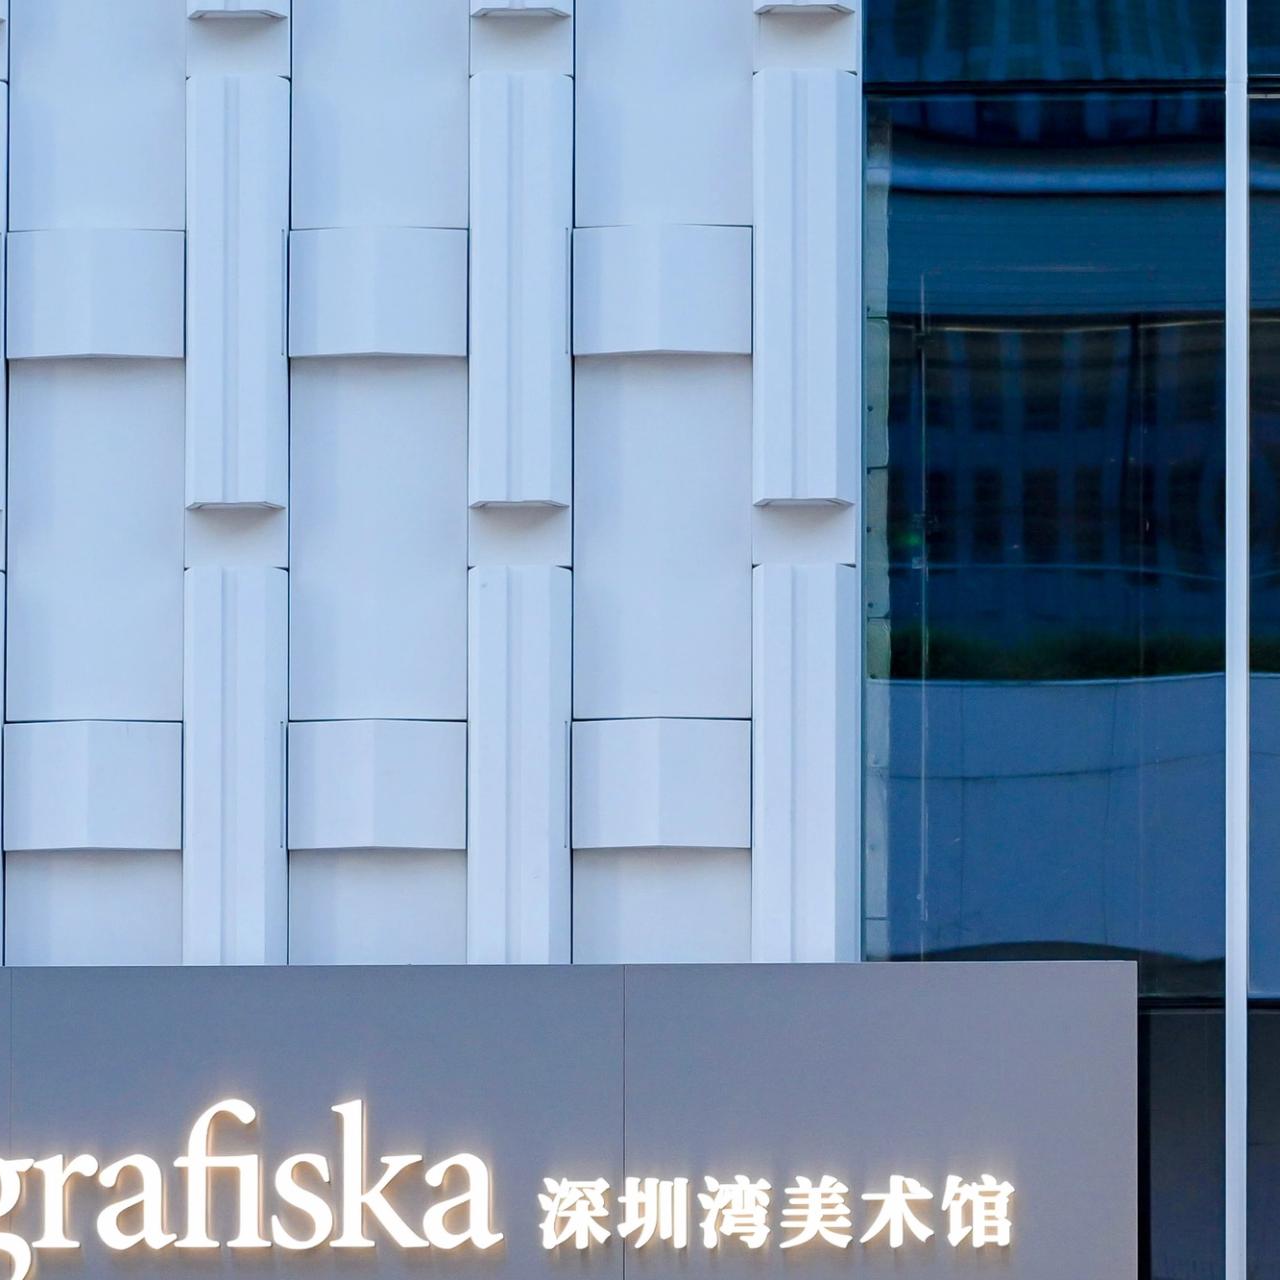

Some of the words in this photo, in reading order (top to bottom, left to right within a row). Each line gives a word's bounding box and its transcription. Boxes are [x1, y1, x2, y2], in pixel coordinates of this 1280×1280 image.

[537, 1173, 1016, 1250] 深圳湾美术馆
